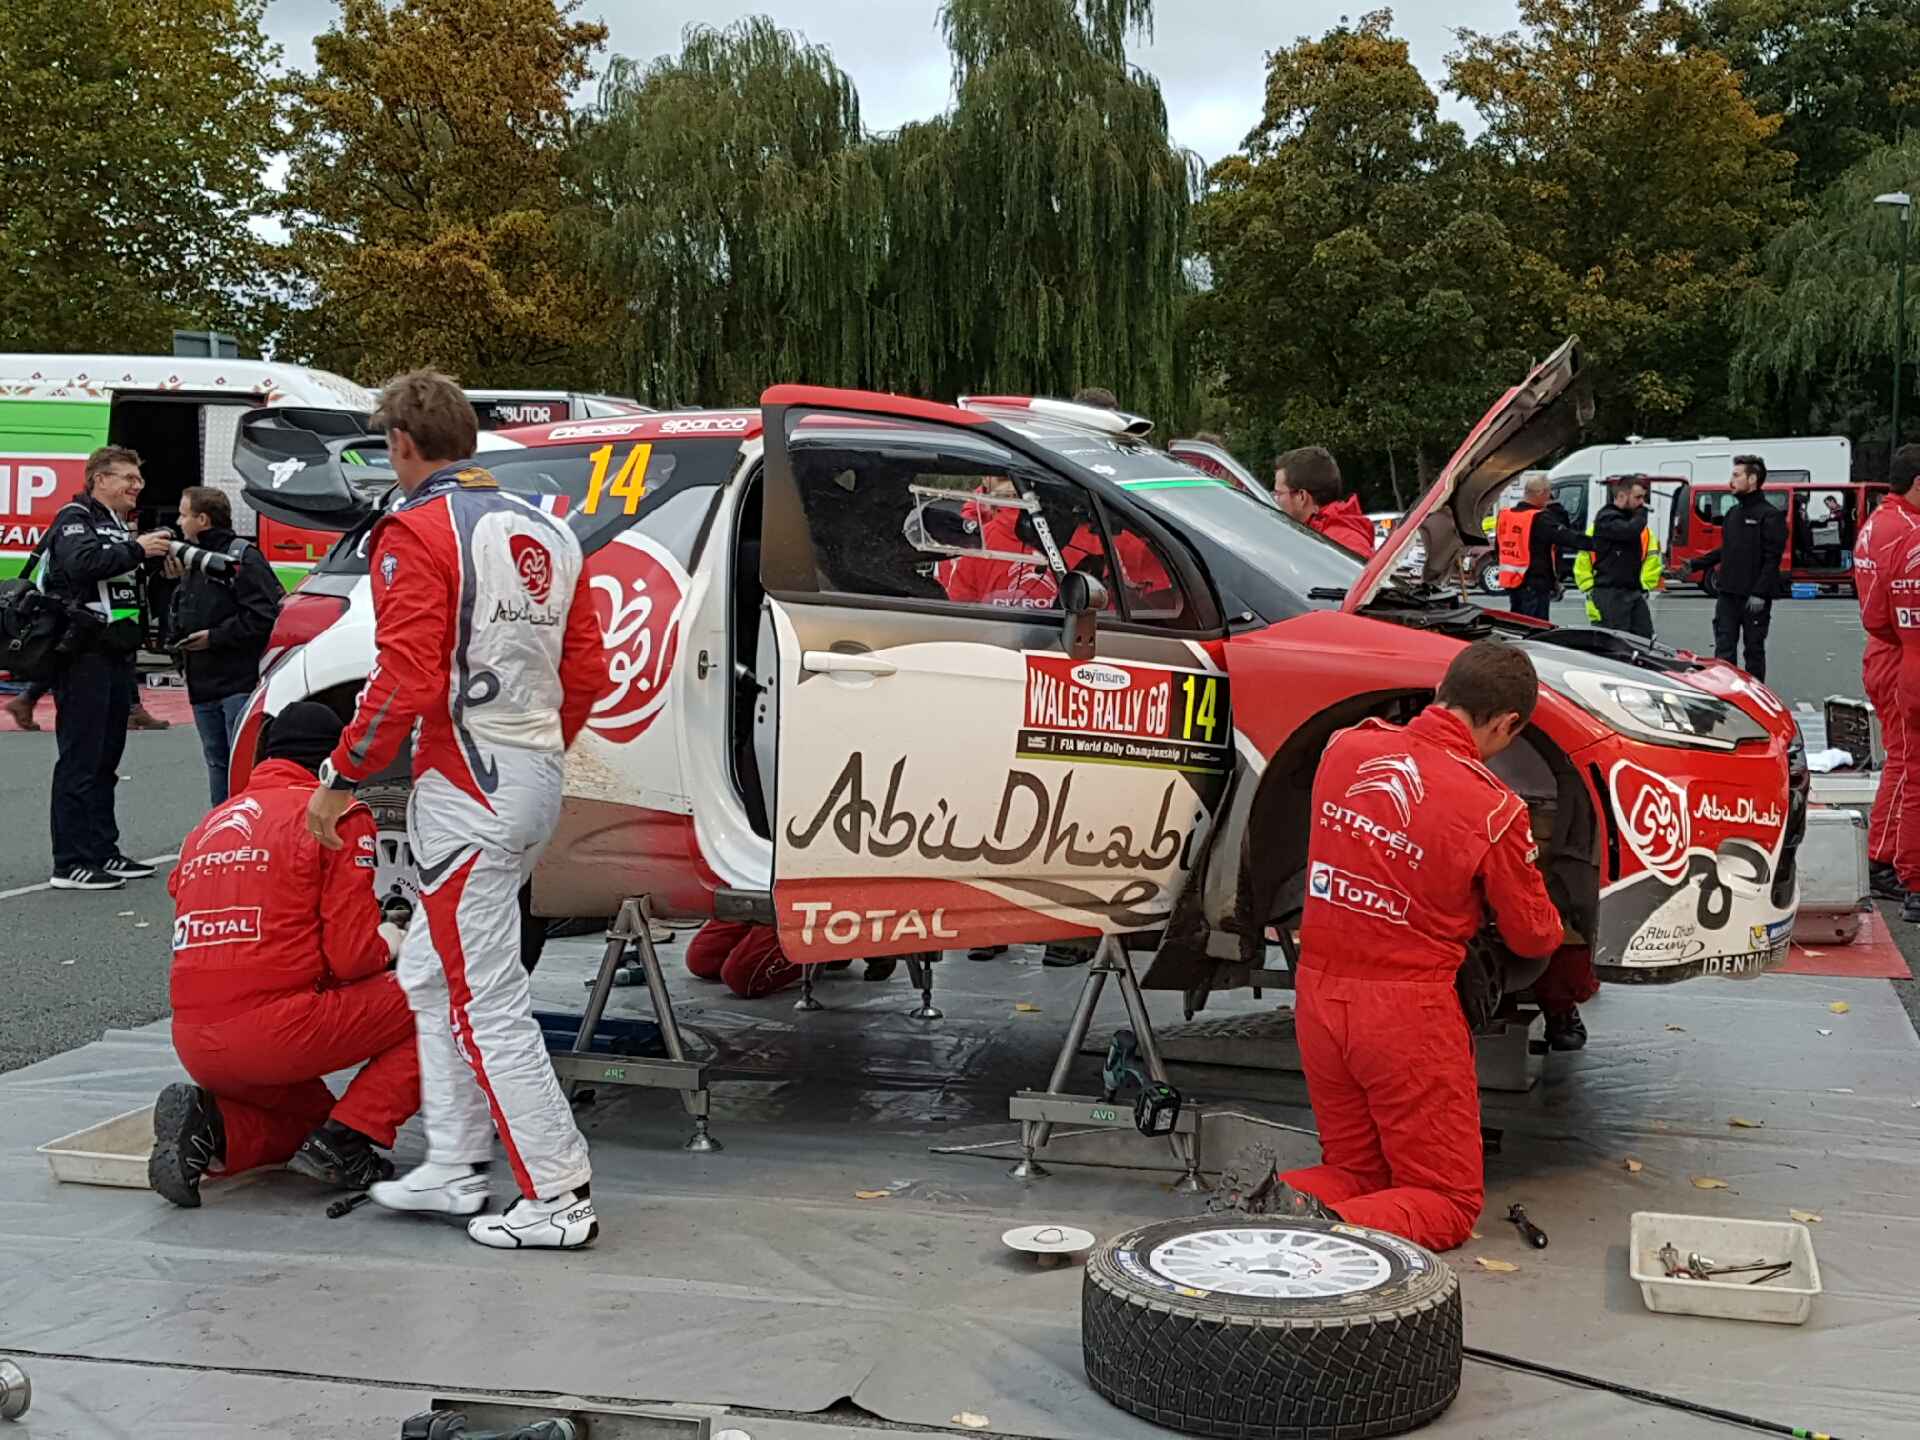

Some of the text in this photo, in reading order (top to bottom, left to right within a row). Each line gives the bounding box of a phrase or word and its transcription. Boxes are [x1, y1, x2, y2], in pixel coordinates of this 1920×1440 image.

[584, 443, 653, 515] 14
[1077, 668, 1126, 685] dayinsure
[1029, 667, 1169, 736] WALES RALLY GB
[1183, 674, 1217, 742] 14
[1060, 738, 1180, 761] FIA World Rally Championship
[1334, 877, 1402, 917] TOTAL
[190, 918, 255, 938] TOTAL
[792, 902, 960, 945] TOTAL
